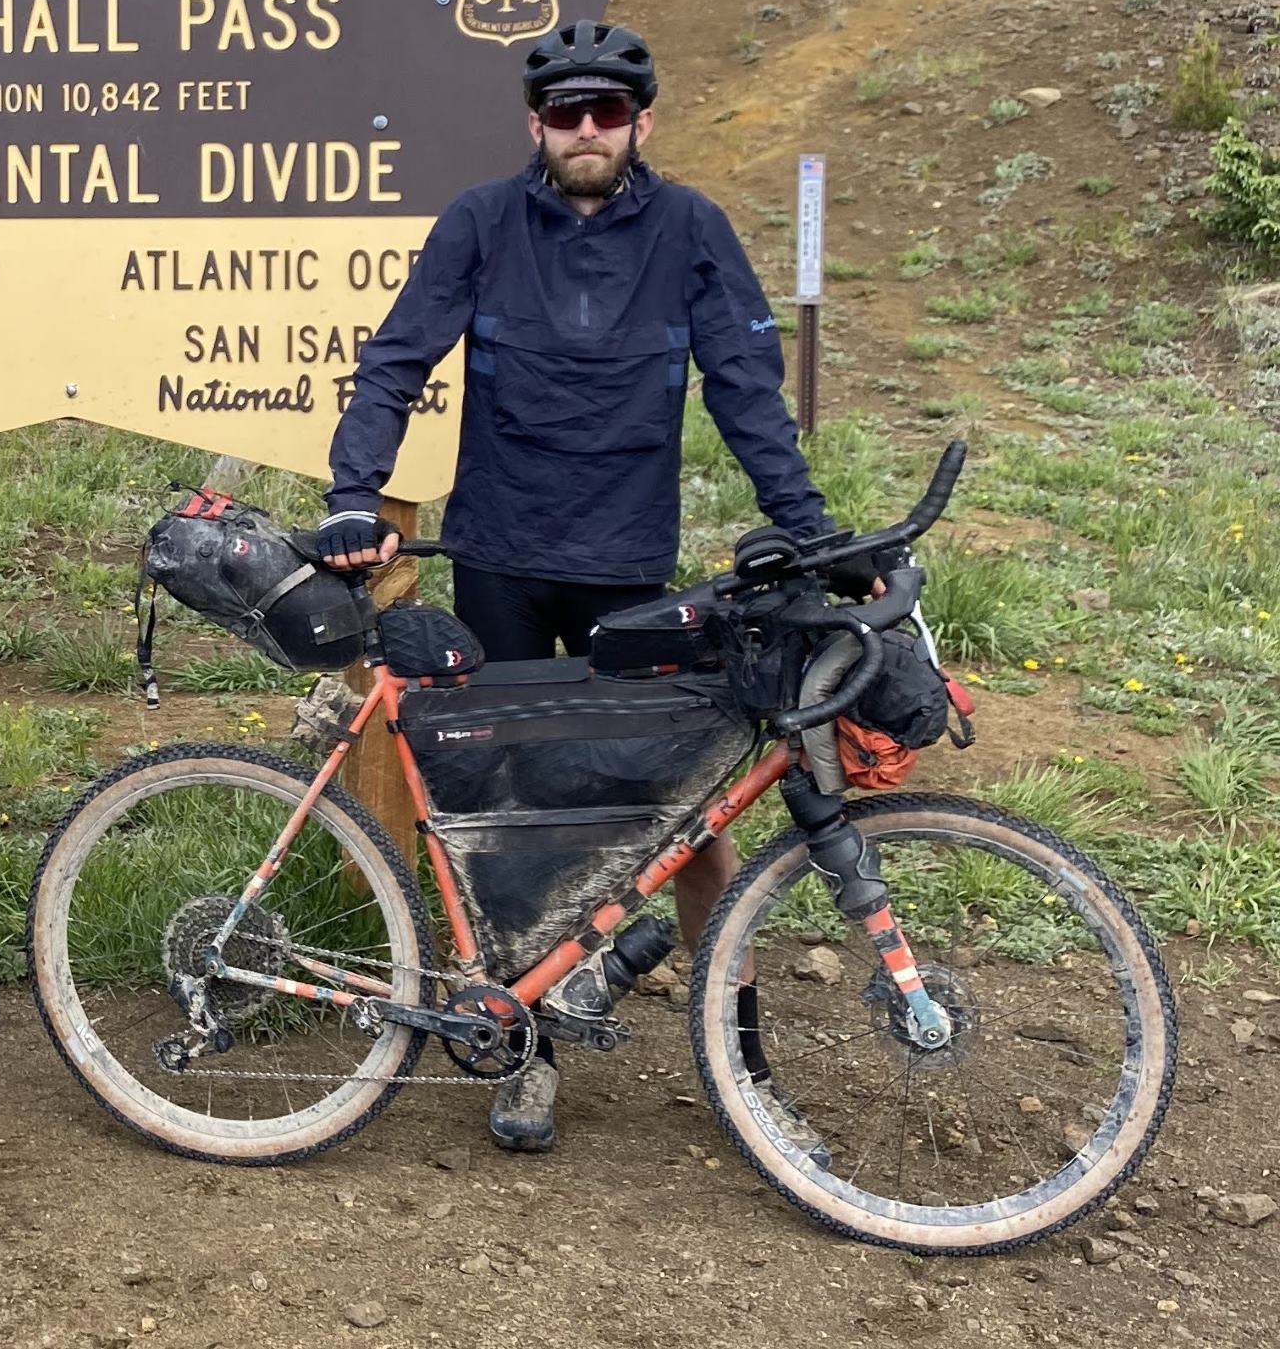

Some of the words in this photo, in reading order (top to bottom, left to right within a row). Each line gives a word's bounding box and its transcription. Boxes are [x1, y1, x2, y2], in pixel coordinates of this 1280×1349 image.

[62, 81, 160, 117] 10,842
[178, 80, 252, 111] FEET
[200, 140, 402, 203] DIVIDE
[120, 249, 318, 291] ATLANTIC
[184, 325, 259, 363] SAN
[158, 374, 314, 414] National
